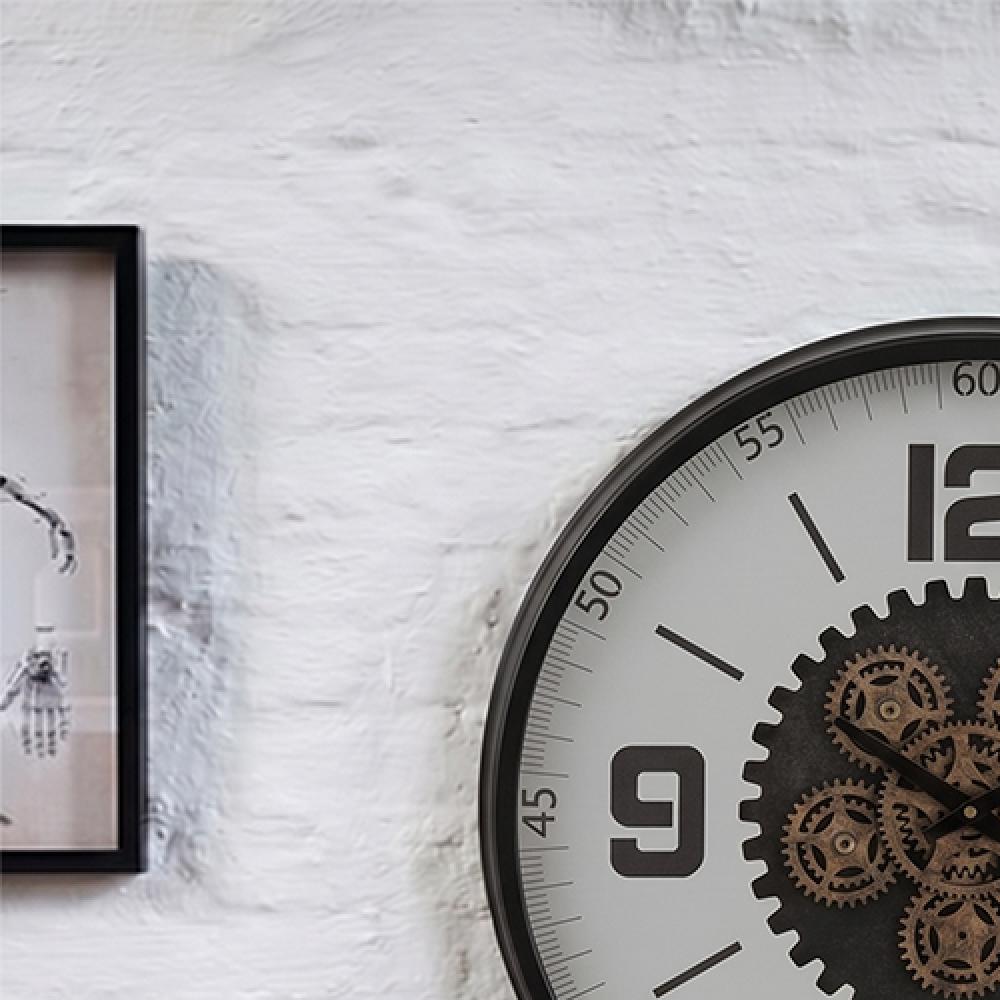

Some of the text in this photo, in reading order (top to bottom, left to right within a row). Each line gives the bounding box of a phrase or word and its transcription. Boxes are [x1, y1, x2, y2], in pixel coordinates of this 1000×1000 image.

[952, 361, 1000, 397] 60
[735, 412, 785, 460] 55
[572, 570, 622, 622] 50
[521, 788, 557, 838] 45
[610, 746, 706, 878] 9
